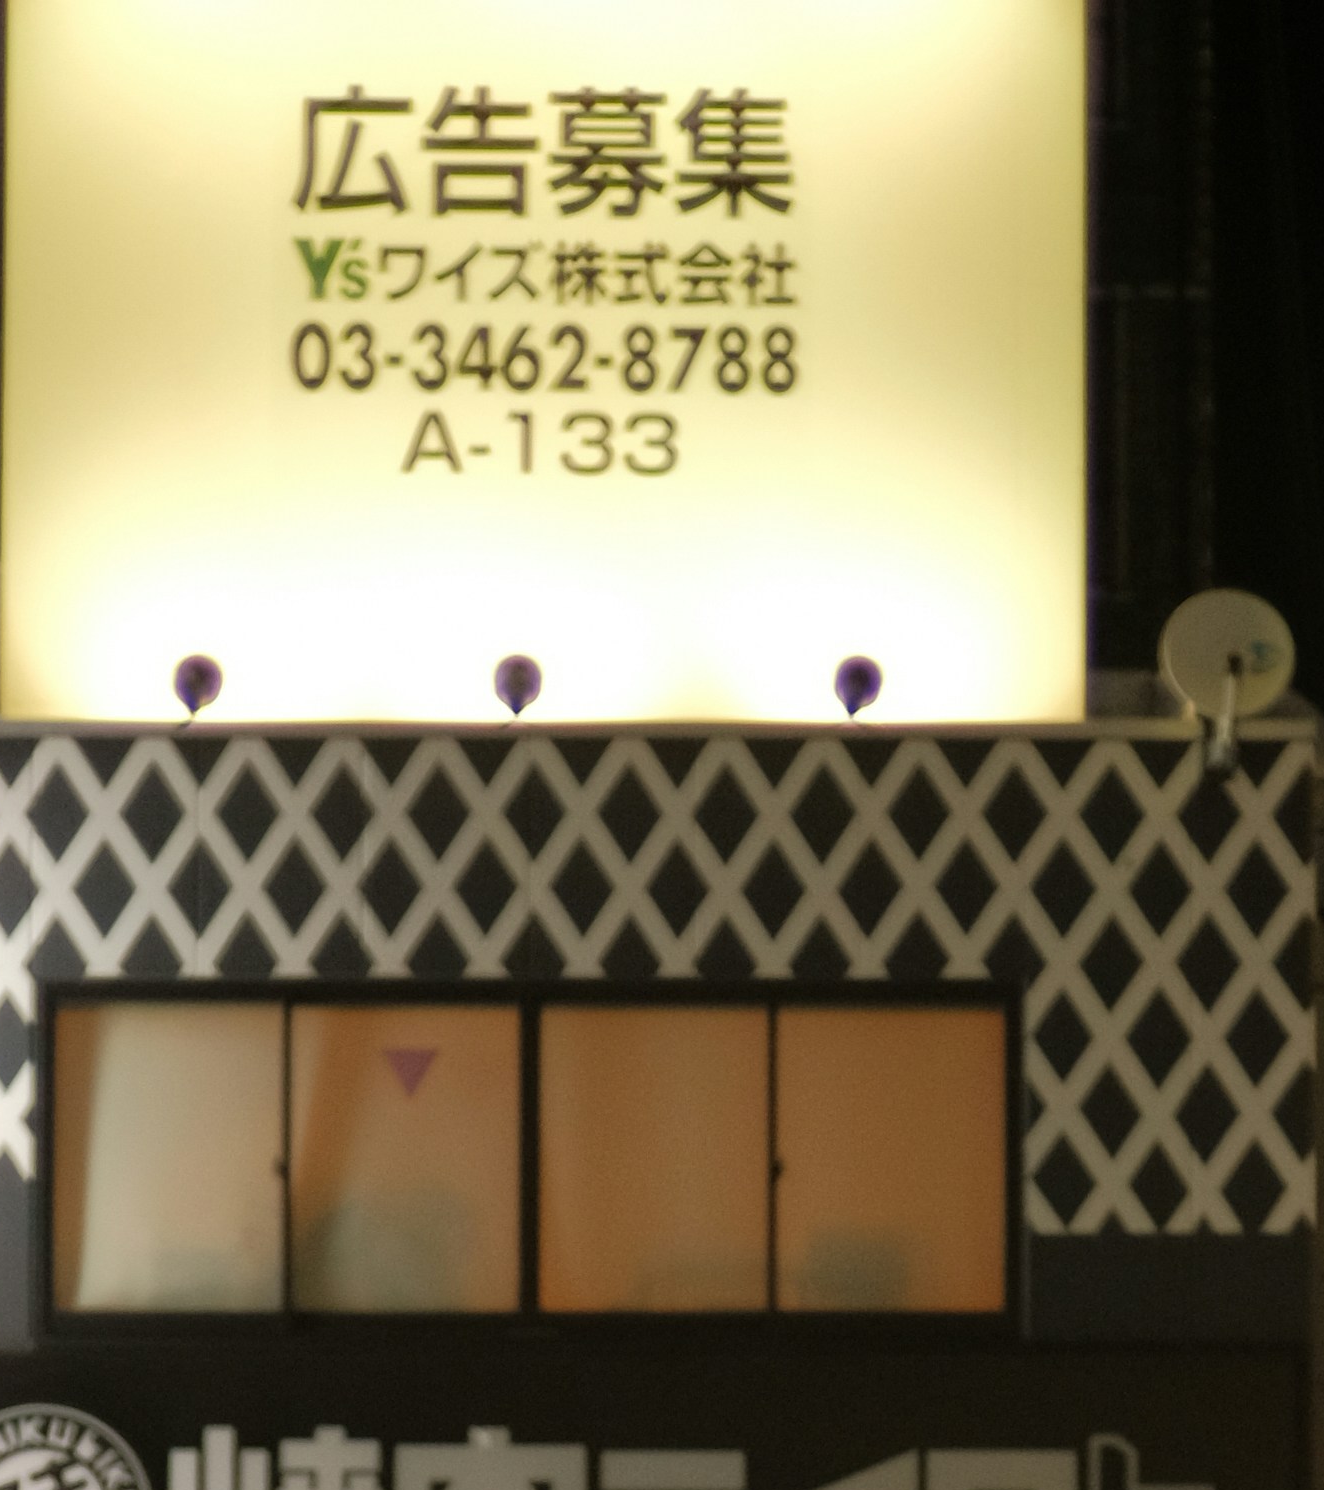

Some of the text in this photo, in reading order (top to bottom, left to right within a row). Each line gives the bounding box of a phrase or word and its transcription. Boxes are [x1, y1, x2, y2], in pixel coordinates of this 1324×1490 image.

[294, 86, 794, 216] 広告募集
[291, 322, 798, 393] 03-3462-8788
[401, 411, 681, 476] A-133
